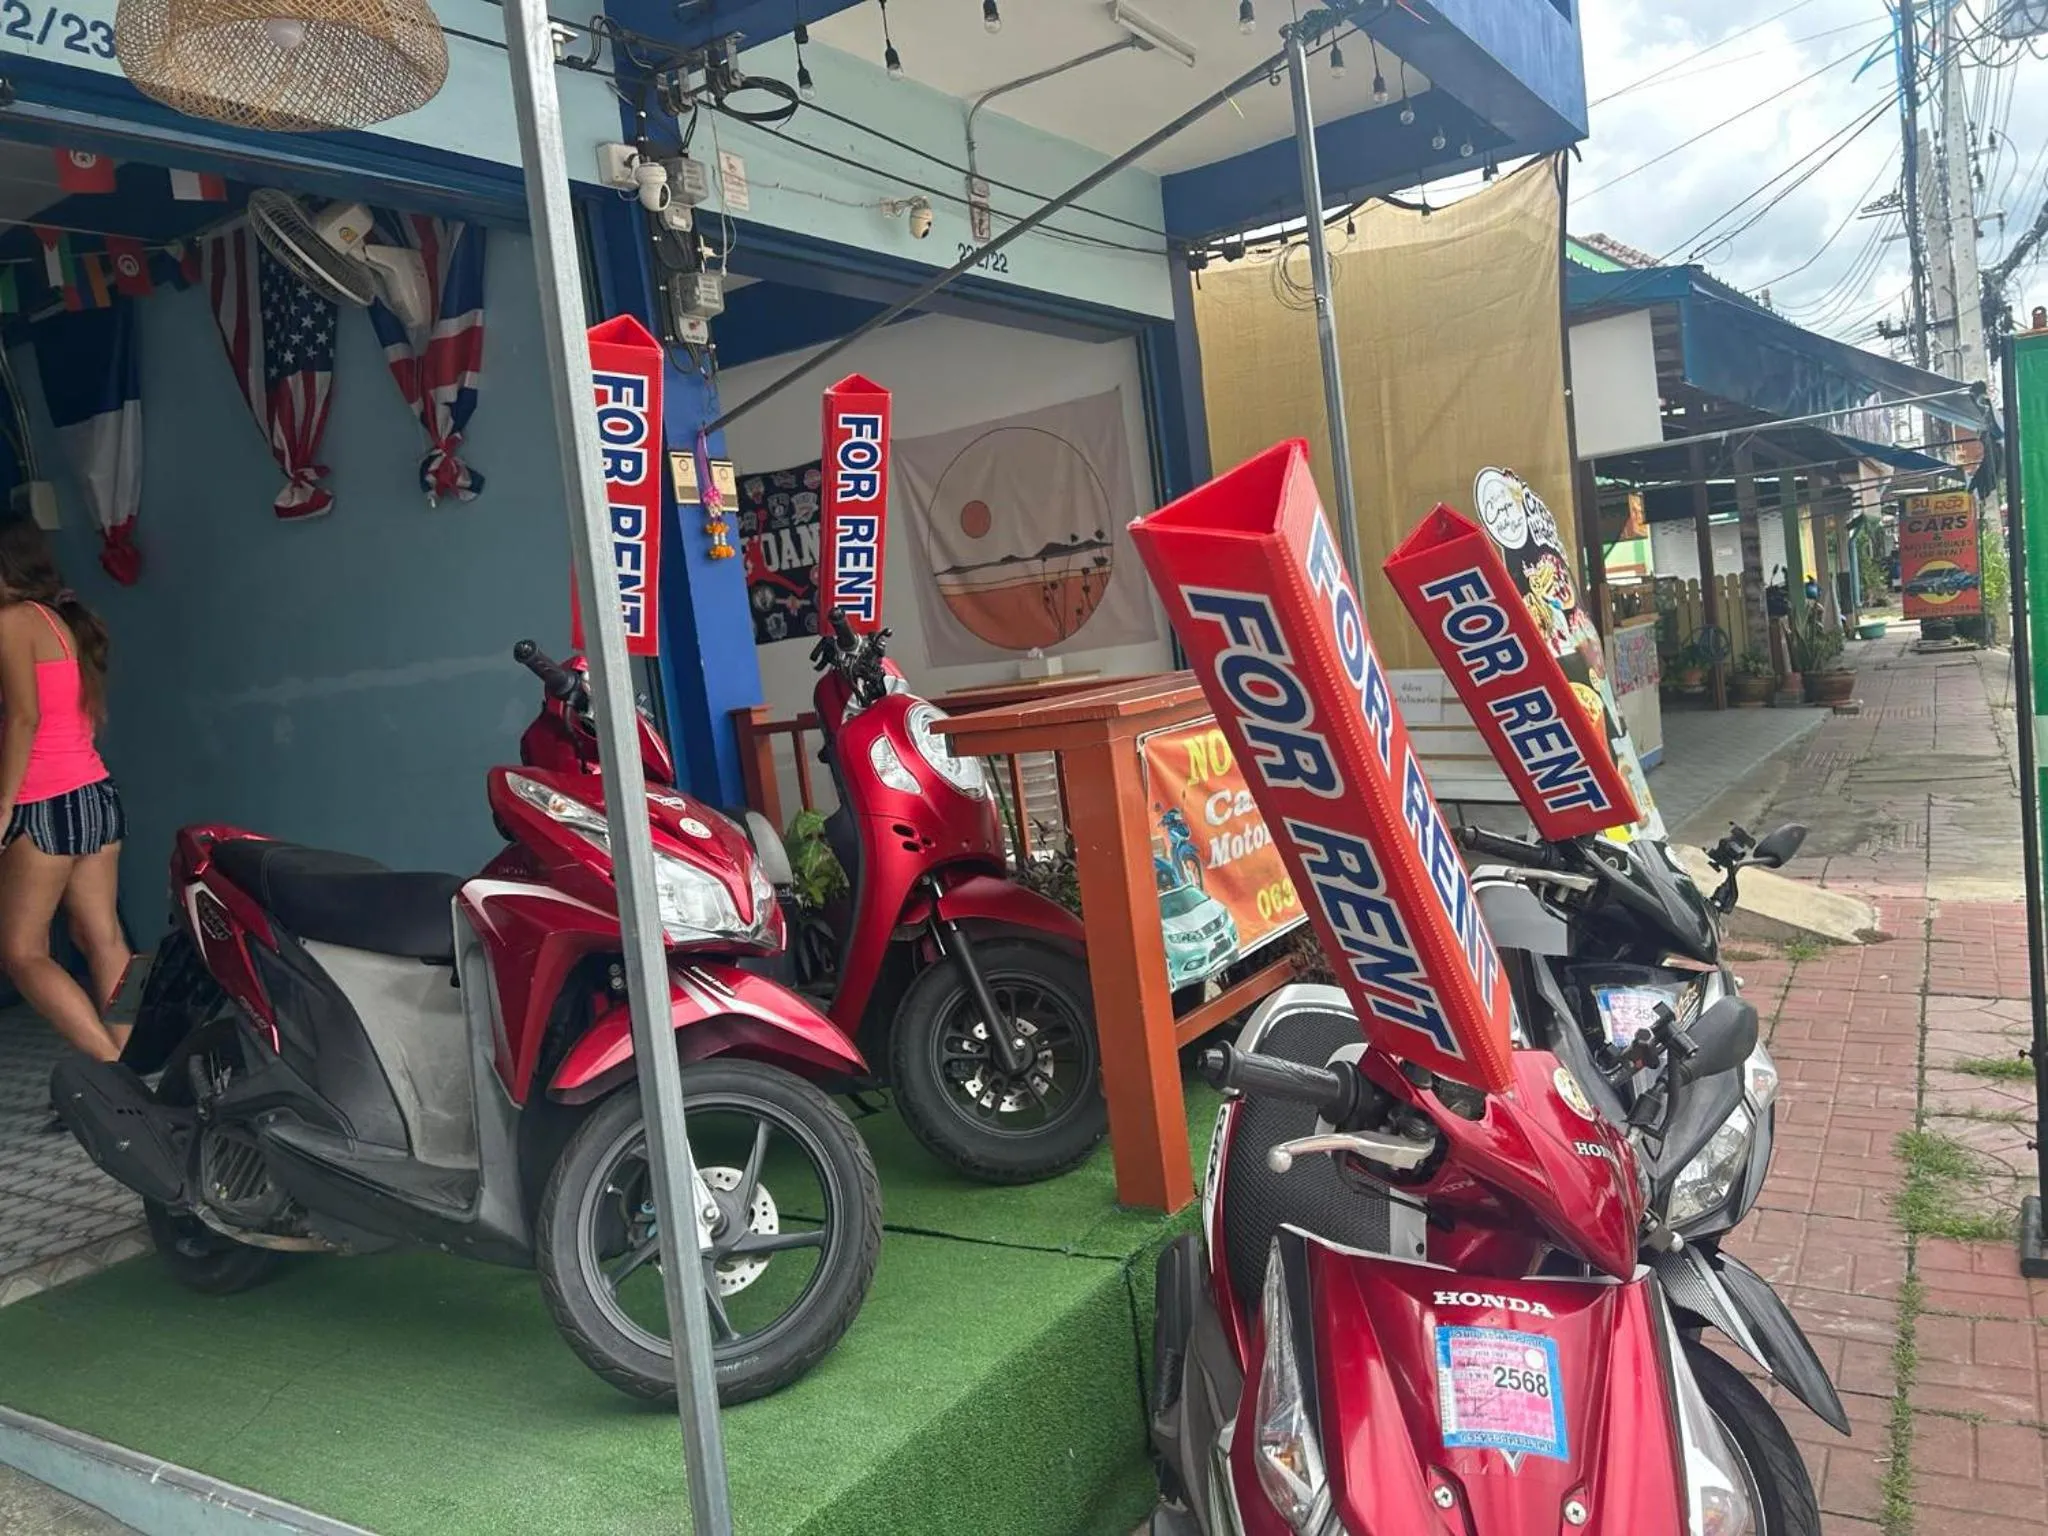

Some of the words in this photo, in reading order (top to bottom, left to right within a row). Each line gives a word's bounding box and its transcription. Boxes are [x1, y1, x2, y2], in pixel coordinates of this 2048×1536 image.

[0, 0, 116, 59] 2/23
[592, 370, 649, 487] FOR
[837, 413, 882, 503] FOR
[1907, 515, 1968, 533] CARS
[834, 515, 879, 622] RENT
[1419, 566, 1528, 688] FOR
[1487, 685, 1612, 813] RENT
[1182, 728, 1233, 787] NO
[1306, 503, 1393, 782] FOR
[1402, 740, 1500, 1019] RENT
[1178, 584, 1345, 799] FOR
[1282, 816, 1466, 1061] RENT
[1205, 788, 1258, 826] Ca
[1433, 1291, 1555, 1319] HONDA
[1493, 1366, 1549, 1398] 2568
